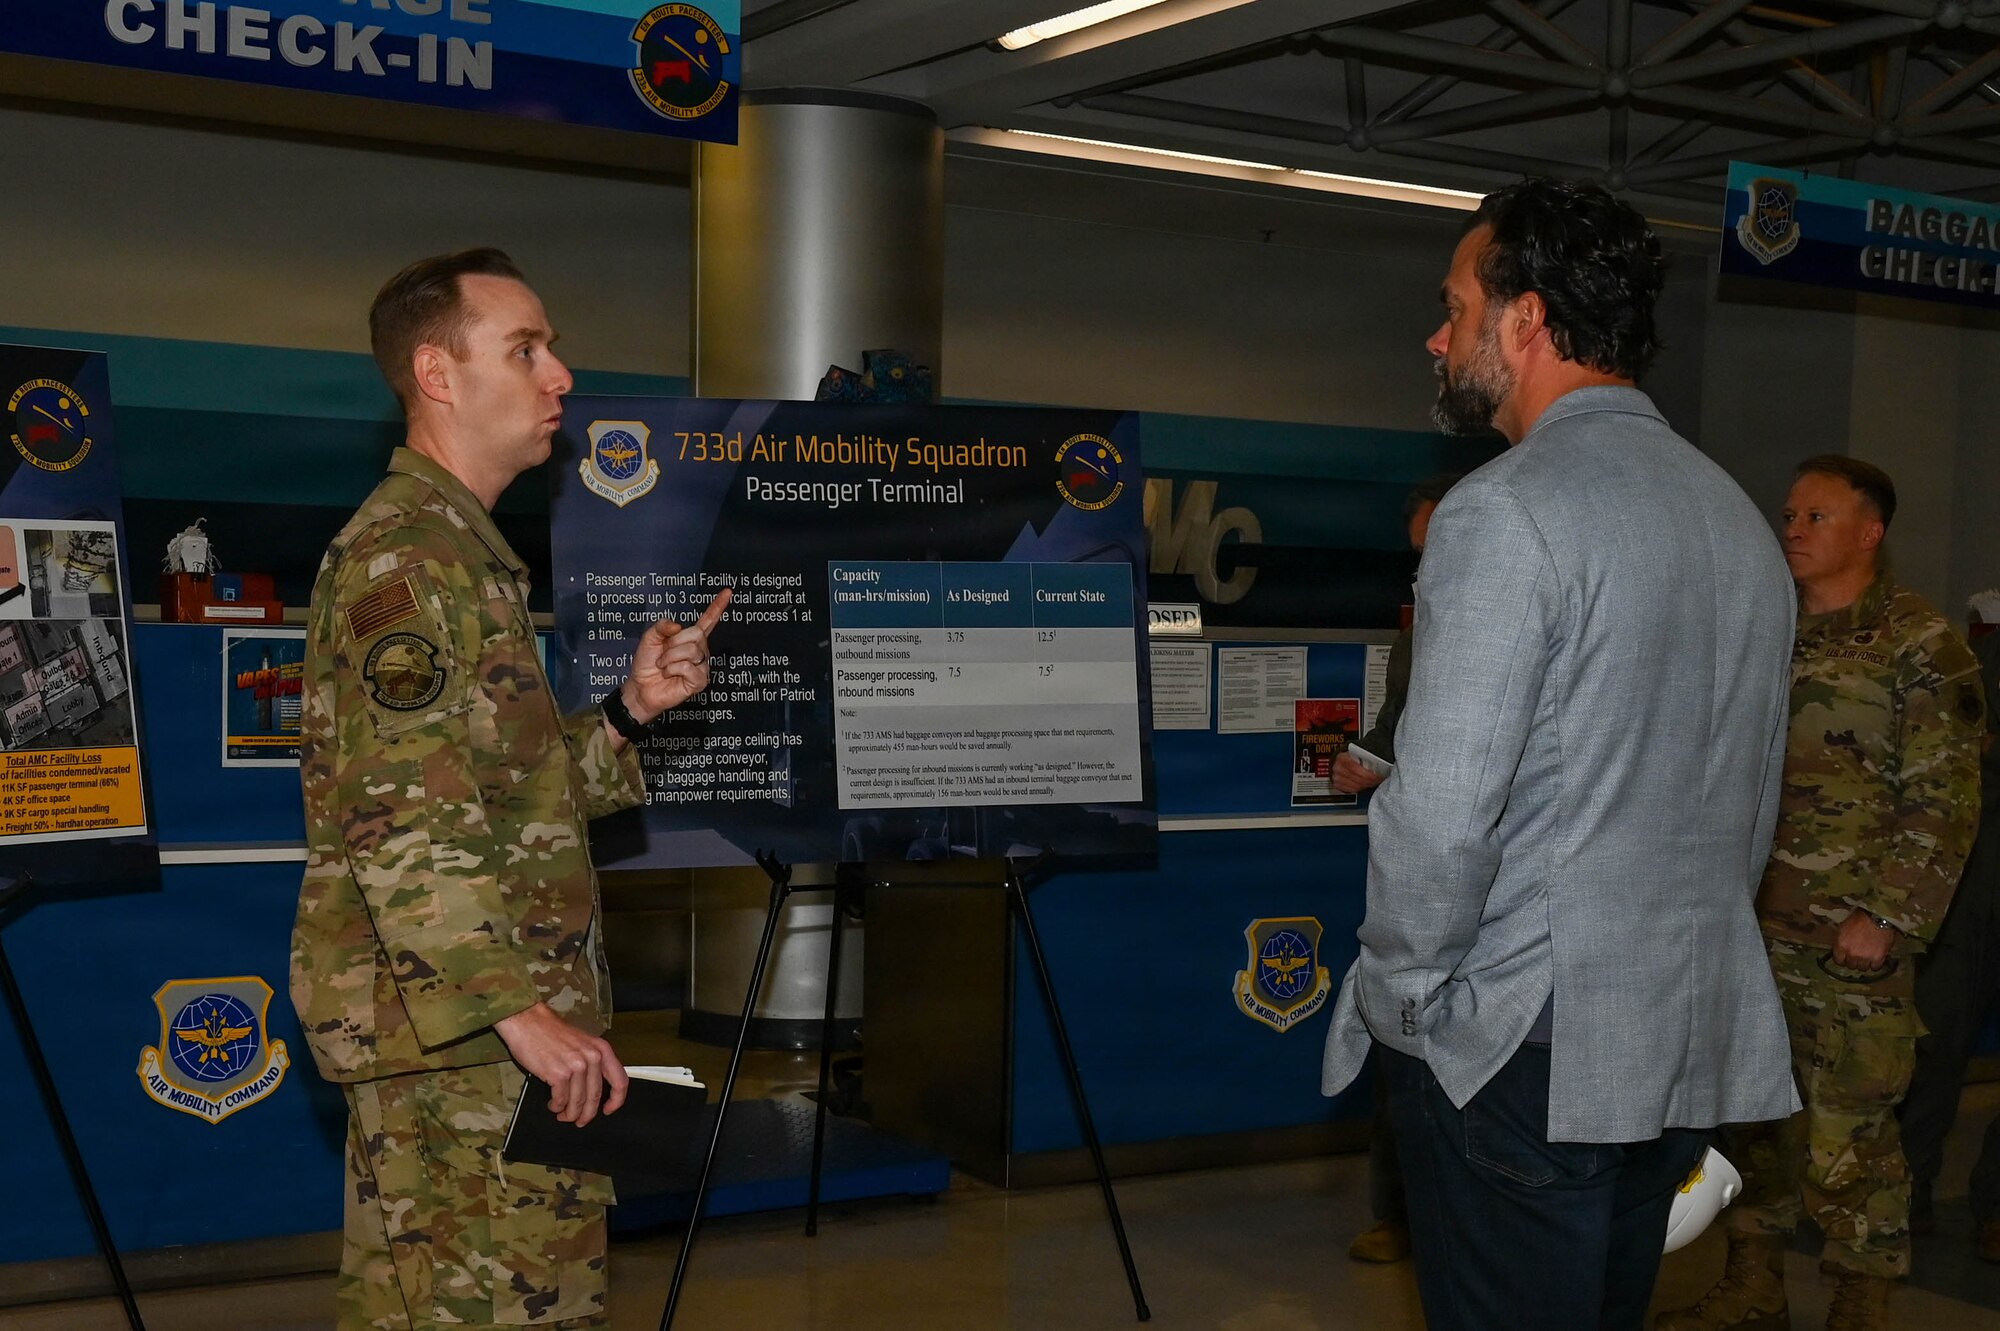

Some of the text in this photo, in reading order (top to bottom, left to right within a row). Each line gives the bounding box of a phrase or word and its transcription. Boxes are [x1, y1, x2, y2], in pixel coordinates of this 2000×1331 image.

[651, 6, 674, 21] ROUTE
[679, 6, 724, 43] PACESETTERS
[104, 0, 493, 91] CHECK-IN
[646, 84, 727, 117] AIR MOBILITY SQUADRON
[1865, 199, 2000, 252] BAGGA
[674, 432, 743, 462] 733d
[751, 434, 787, 463] Air
[796, 434, 899, 473] Mobility
[907, 436, 1027, 474] Squadron
[585, 474, 654, 501] AIR MOBILITY COMMAND
[746, 476, 964, 509] Passenger Terminal
[586, 573, 802, 590] Passenger Terminal Facility is designed
[833, 568, 881, 584] Capacity
[587, 591, 806, 608] to process up to 3 aircraft at
[833, 589, 1106, 605] (man-hrs/mission) As Designed Current State
[588, 612, 595, 622] a
[598, 610, 626, 624] time,
[732, 610, 743, 622] to
[746, 611, 789, 625] process
[792, 610, 797, 622] 1
[801, 610, 812, 622] at
[588, 628, 626, 641] a time.
[835, 632, 875, 646] Passenger
[877, 632, 922, 646] processing,
[948, 632, 964, 643] 3.75
[92, 636, 114, 683] Inbound
[589, 653, 789, 670] Two of gates have
[835, 648, 911, 660] outbound missions
[1840, 650, 1857, 660] AIR
[1857, 651, 1888, 666] FORCE
[42, 656, 76, 680] Outbound
[838, 669, 885, 683] Passenger
[888, 668, 938, 682] processing,
[949, 667, 961, 678] 7.5
[590, 670, 800, 690] been sqft), with the
[710, 688, 816, 702] too small for Patriot
[838, 686, 915, 698] inbound missions
[62, 696, 84, 713] Lobby
[16, 705, 38, 723] Admin
[668, 709, 736, 724] passengers.
[652, 732, 803, 750] baggage garage ceiling has
[852, 732, 861, 740] the
[863, 731, 874, 740] 733
[875, 731, 892, 740] AMS
[893, 730, 904, 739] had
[906, 730, 931, 740] baggage
[932, 731, 963, 739] conveyors
[964, 730, 975, 739] and
[976, 729, 1000, 740] baggage
[1002, 729, 1032, 738] processing
[1052, 728, 1063, 737] that
[1076, 728, 1115, 737] requirements,
[1302, 734, 1344, 744] FIREWORKS
[848, 742, 985, 754] approximately 455 man-hours would saved
[6, 753, 102, 766] Total AMC Facility Loss
[644, 752, 768, 769] the baggage conveyor,
[0, 764, 131, 780] of facilities condemned/vacated
[667, 768, 788, 787] baggage handling and
[2, 783, 15, 793] 11K
[17, 782, 27, 791] SF
[29, 782, 67, 793] passenger
[69, 779, 98, 789] terminal
[3, 794, 71, 805] 4K SF office space
[655, 787, 791, 805] manpower requirements.
[4, 804, 110, 818] 9K SF cargo special handling
[6, 822, 32, 833] Freight
[85, 818, 118, 828] operation
[1243, 990, 1326, 1026] AIR MOBILITY COMMAND
[148, 1066, 280, 1115] AIR MOBILITY COMMAND
